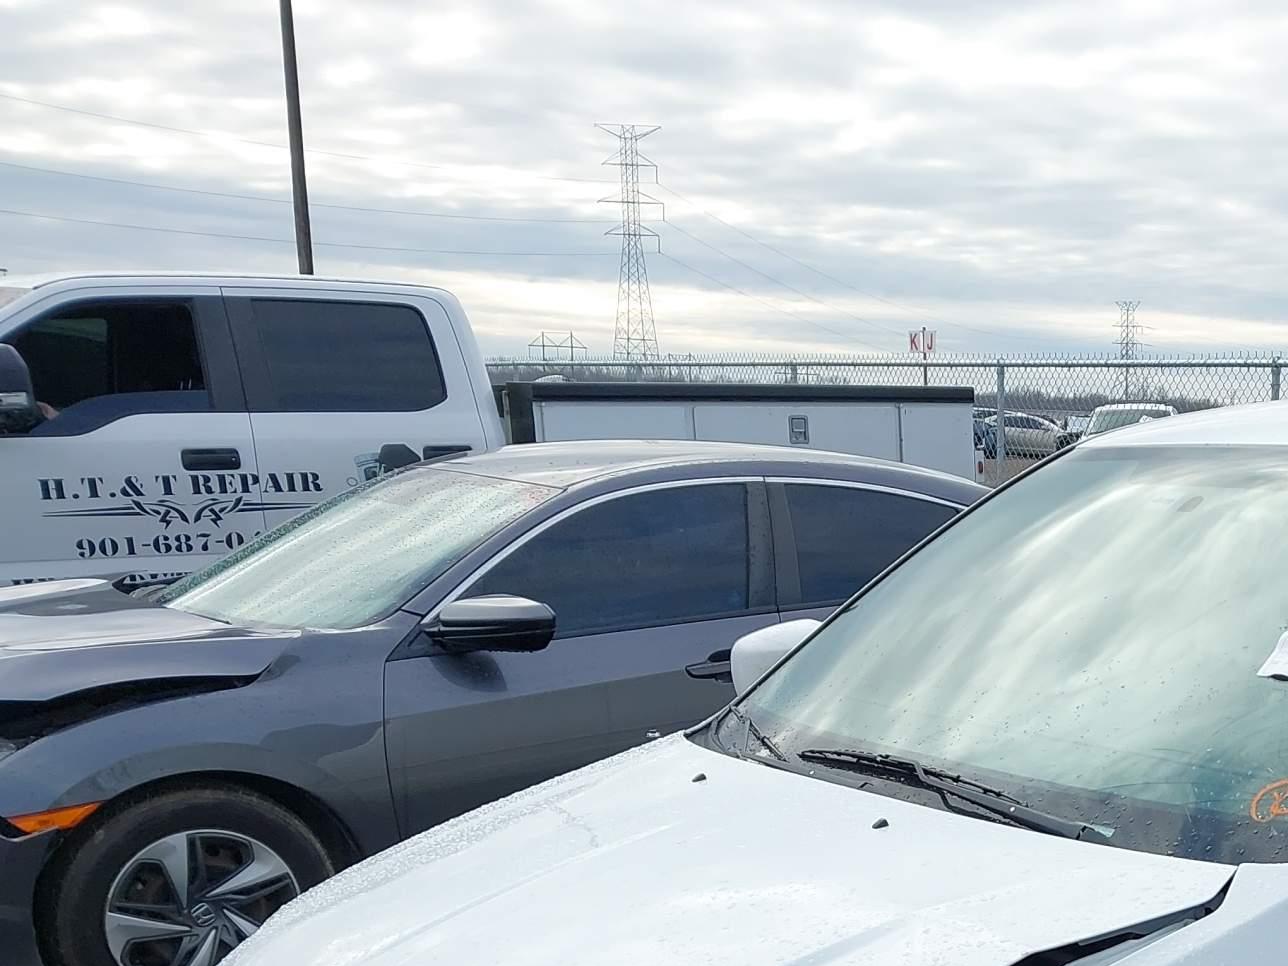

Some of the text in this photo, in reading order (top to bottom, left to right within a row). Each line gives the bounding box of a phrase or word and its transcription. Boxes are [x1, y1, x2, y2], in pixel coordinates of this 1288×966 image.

[155, 474, 177, 496] T
[188, 471, 324, 495] REPAIR
[75, 530, 261, 559] 901-687-0
